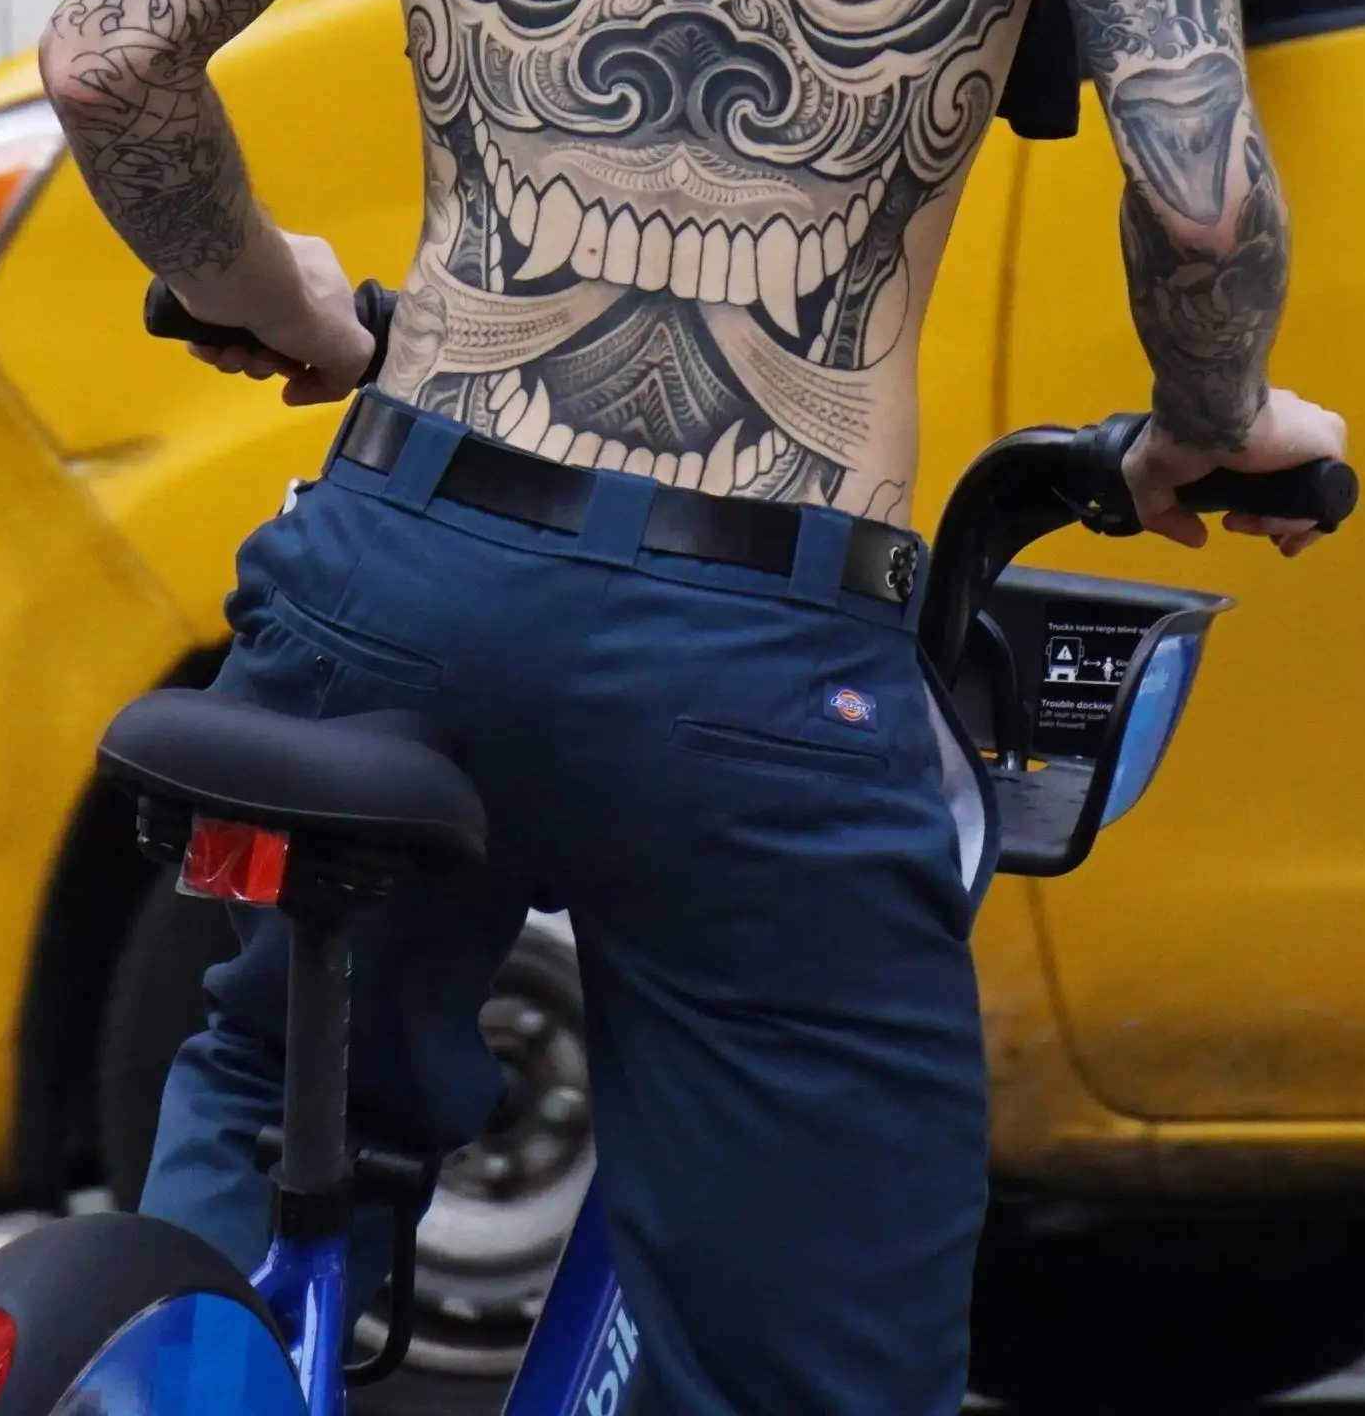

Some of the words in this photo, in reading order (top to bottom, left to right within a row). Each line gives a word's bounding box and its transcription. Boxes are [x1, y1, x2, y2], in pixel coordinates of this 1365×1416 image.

[1048, 622, 1074, 632] Trucks
[1041, 698, 1075, 709] Trouble
[1076, 701, 1114, 712] docking
